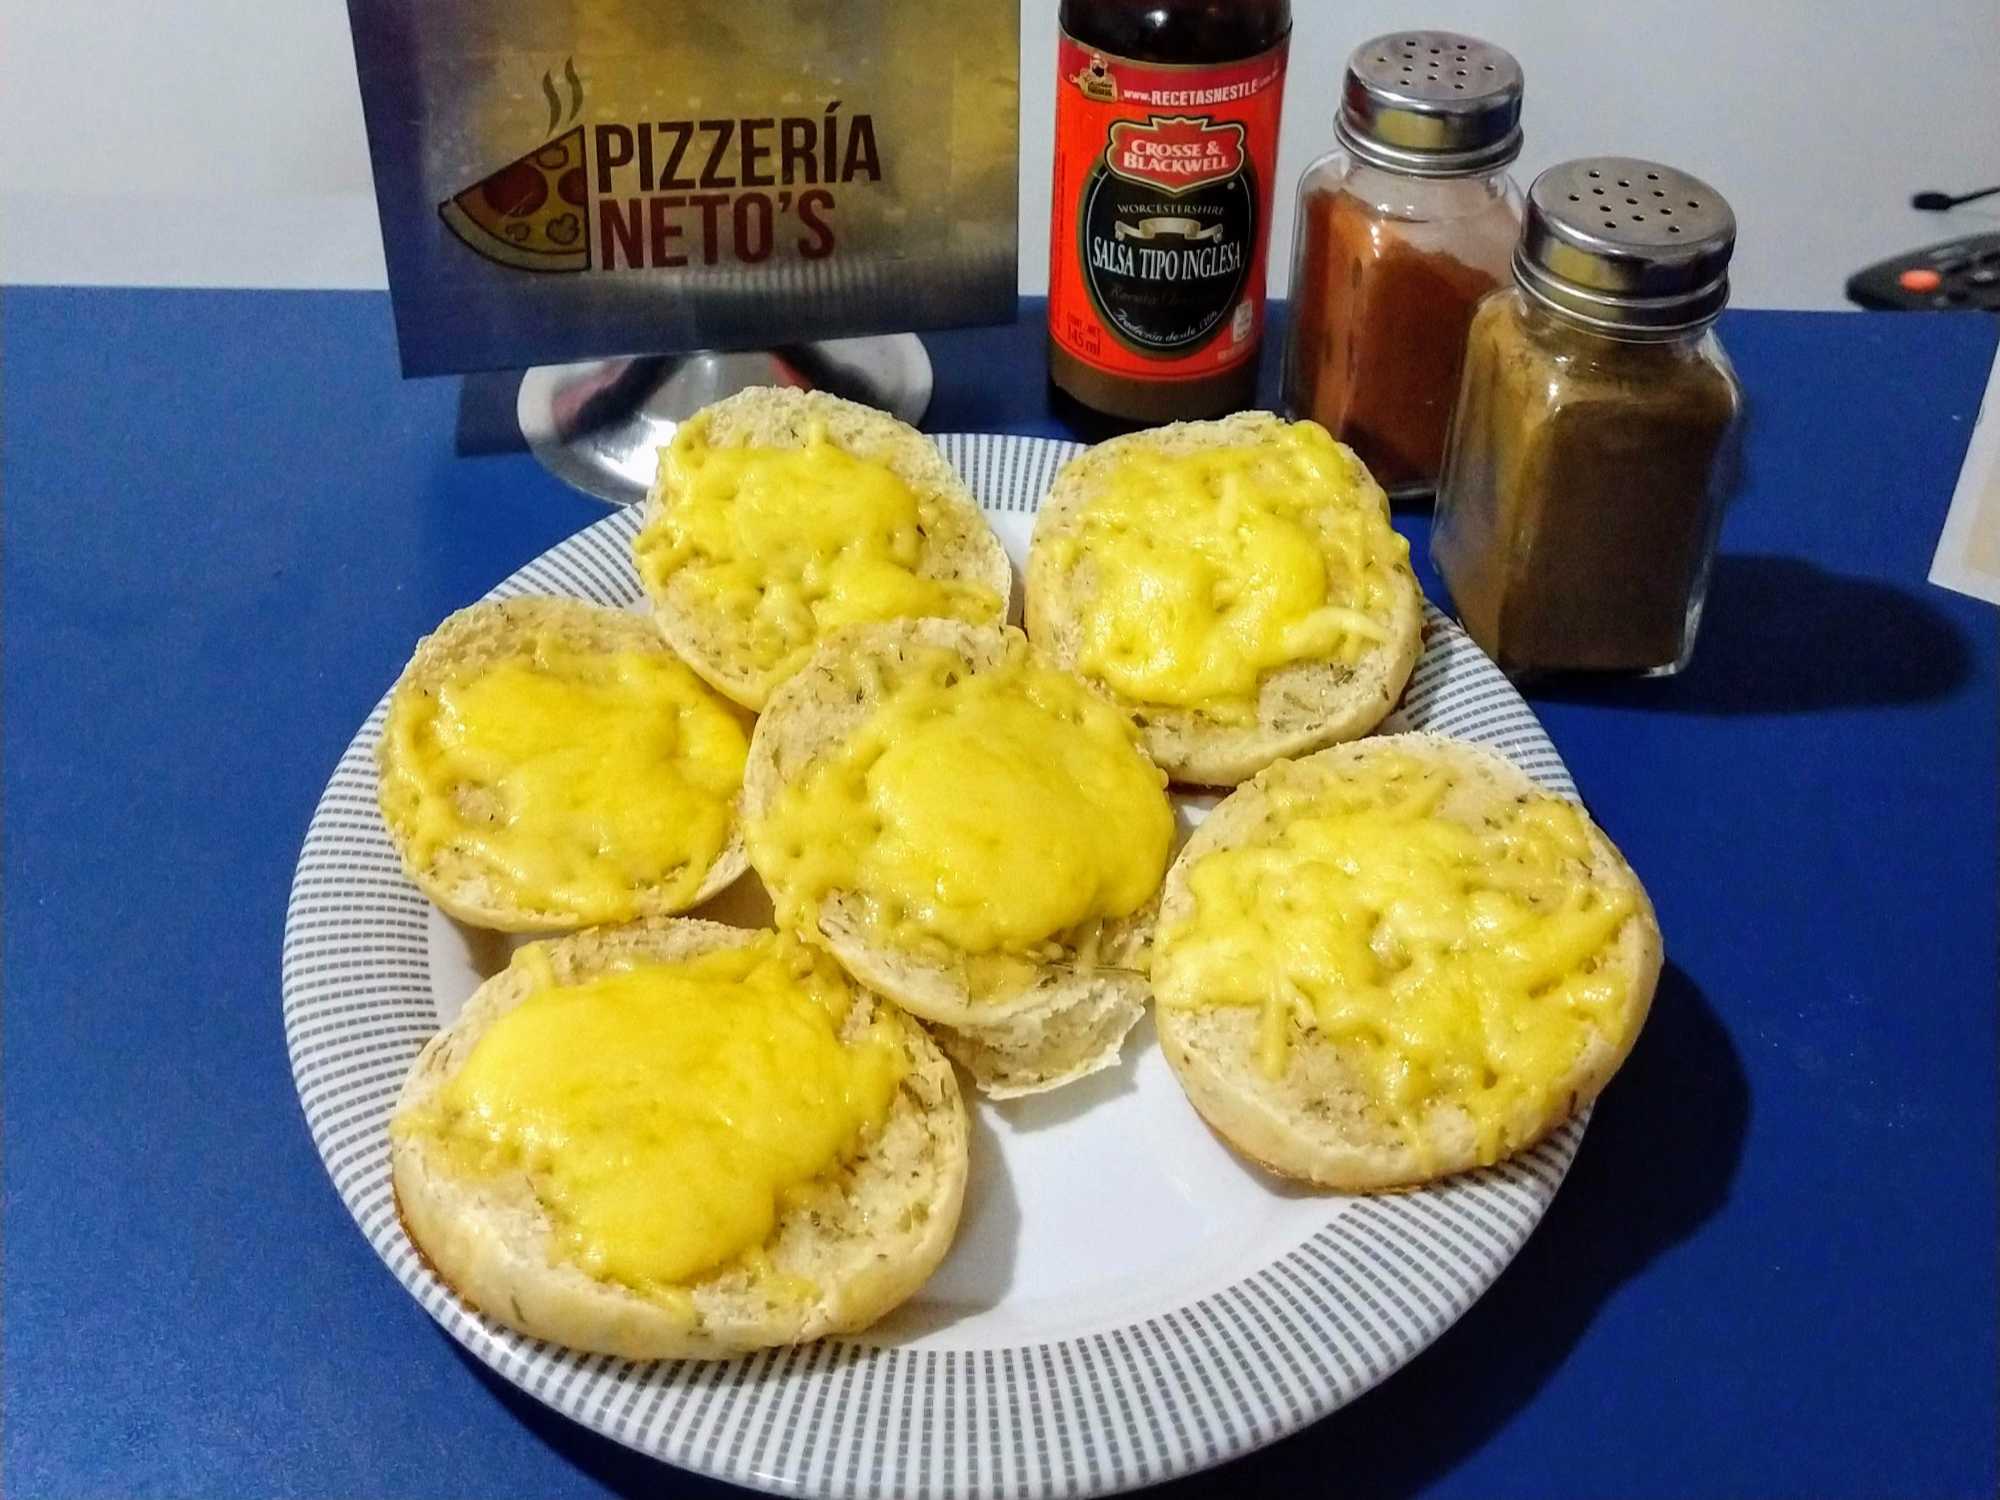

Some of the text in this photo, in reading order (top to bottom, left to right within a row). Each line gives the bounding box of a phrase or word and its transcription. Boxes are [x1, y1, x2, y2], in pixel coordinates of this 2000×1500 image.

[595, 101, 881, 194] PIZZERÍA
[1123, 152, 1229, 175] BLACKWELL
[1131, 139, 1223, 159] CROSSE &
[1116, 203, 1224, 215] WORCESTERSHIRE
[599, 190, 836, 271] NETO'S
[1093, 236, 1240, 280] SALSA TIPO INGLESA
